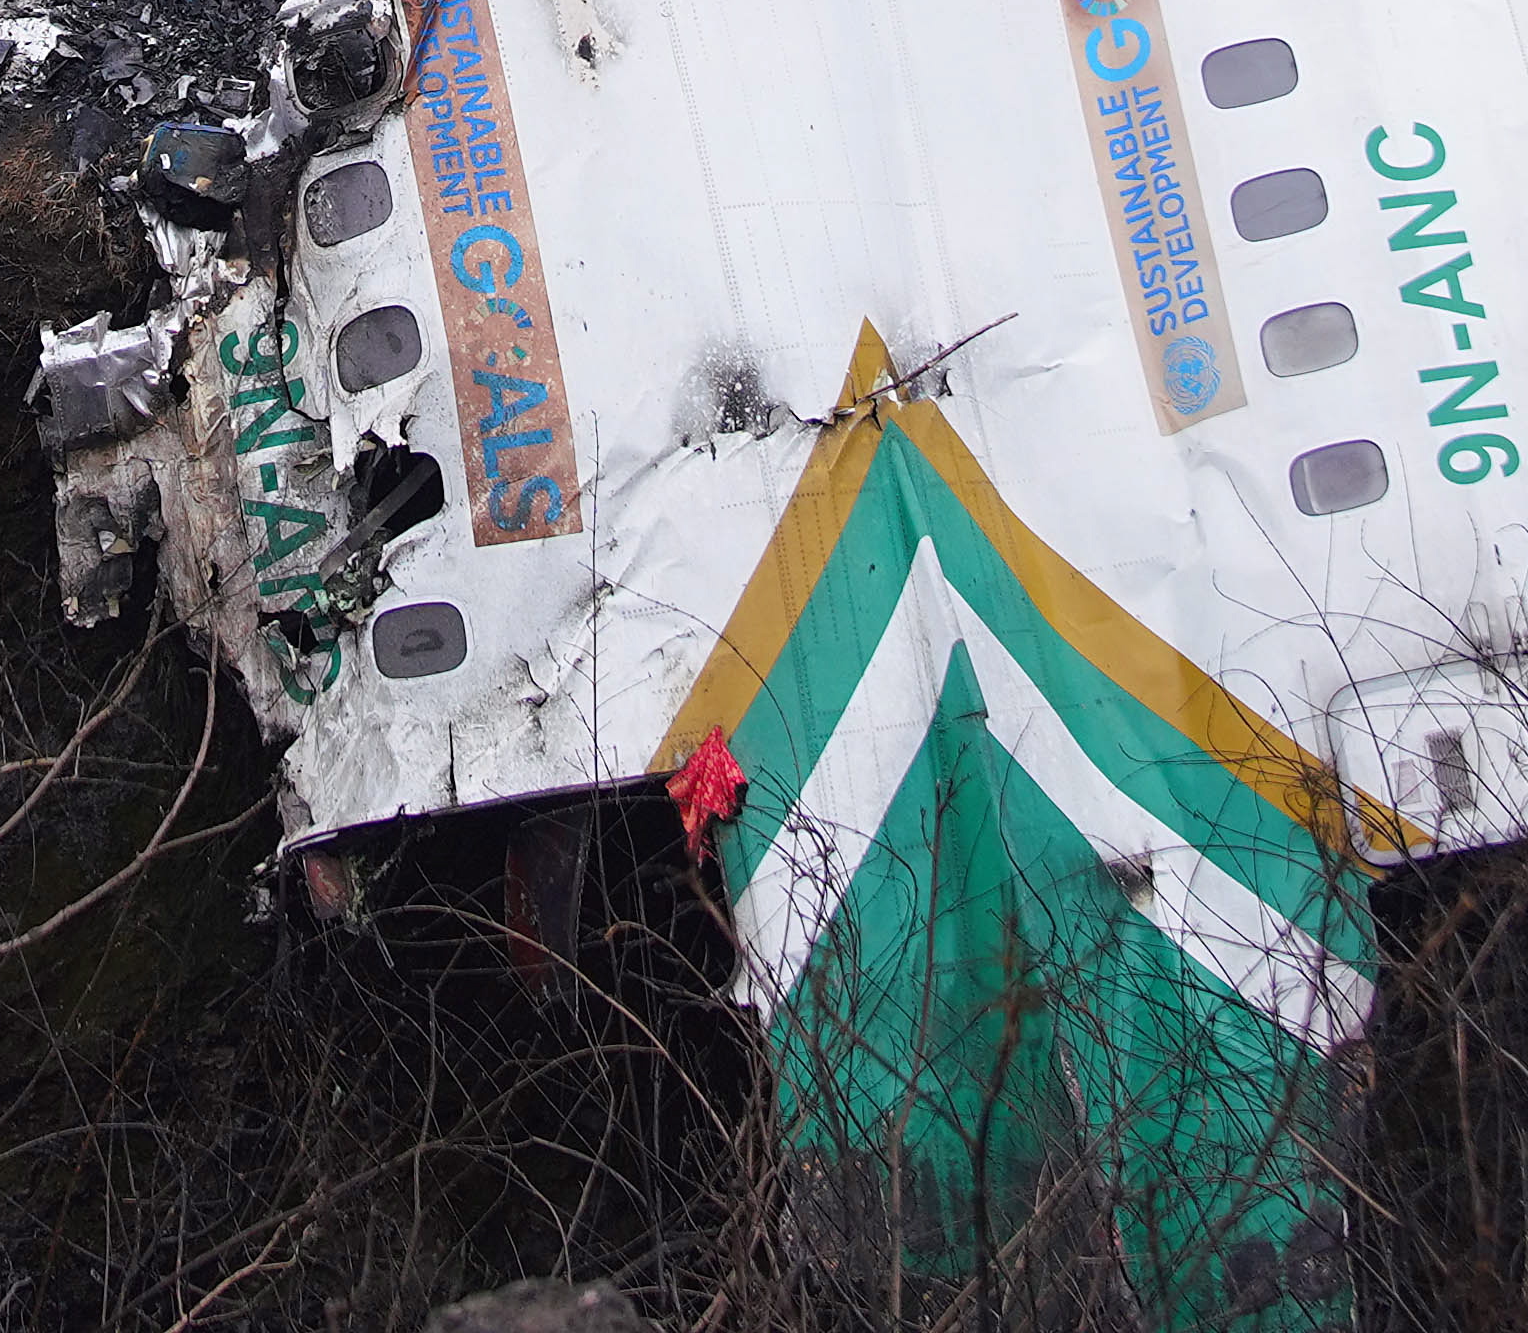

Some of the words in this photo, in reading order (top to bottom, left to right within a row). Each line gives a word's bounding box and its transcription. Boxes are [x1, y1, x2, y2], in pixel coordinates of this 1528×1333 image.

[1097, 90, 1177, 336] SUSTAINABLE
[1132, 86, 1209, 324] DEVELOPMENT
[1365, 122, 1520, 485] 9N-ANC
